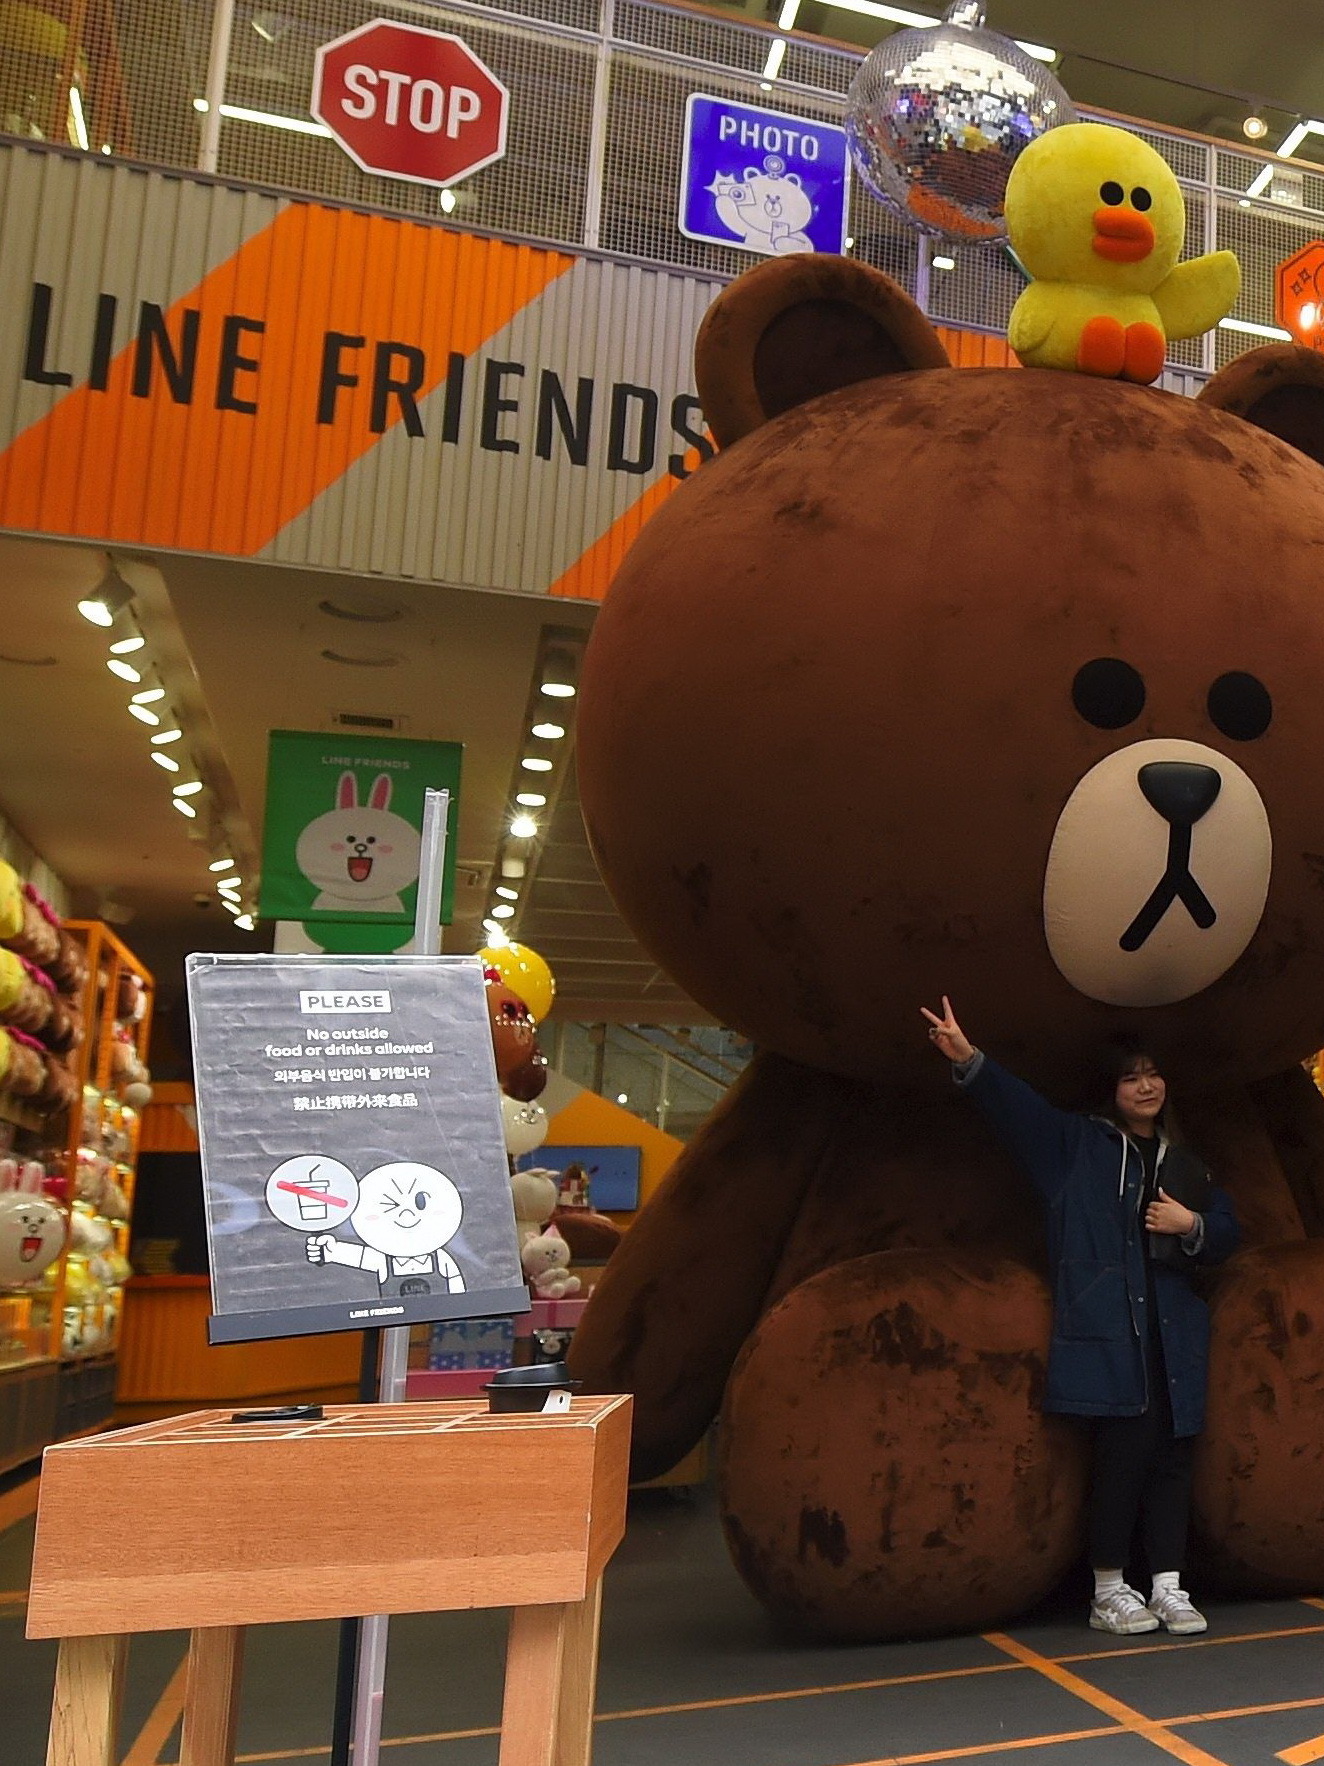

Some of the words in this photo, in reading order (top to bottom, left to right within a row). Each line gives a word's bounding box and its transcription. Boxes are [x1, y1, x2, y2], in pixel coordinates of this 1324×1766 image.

[341, 64, 481, 139] STOP
[719, 115, 819, 161] PHOTO
[24, 281, 266, 415] LINE
[316, 330, 715, 480] FRIENDS
[307, 995, 384, 1008] PLEASE
[306, 1028, 330, 1041] No
[331, 1027, 390, 1041] outside
[264, 1044, 303, 1057] food
[304, 1048, 322, 1057] or
[324, 1043, 373, 1056] drinks
[374, 1042, 434, 1055] allowed
[274, 1069, 326, 1083] 외부음식
[327, 1067, 367, 1082] 반입이
